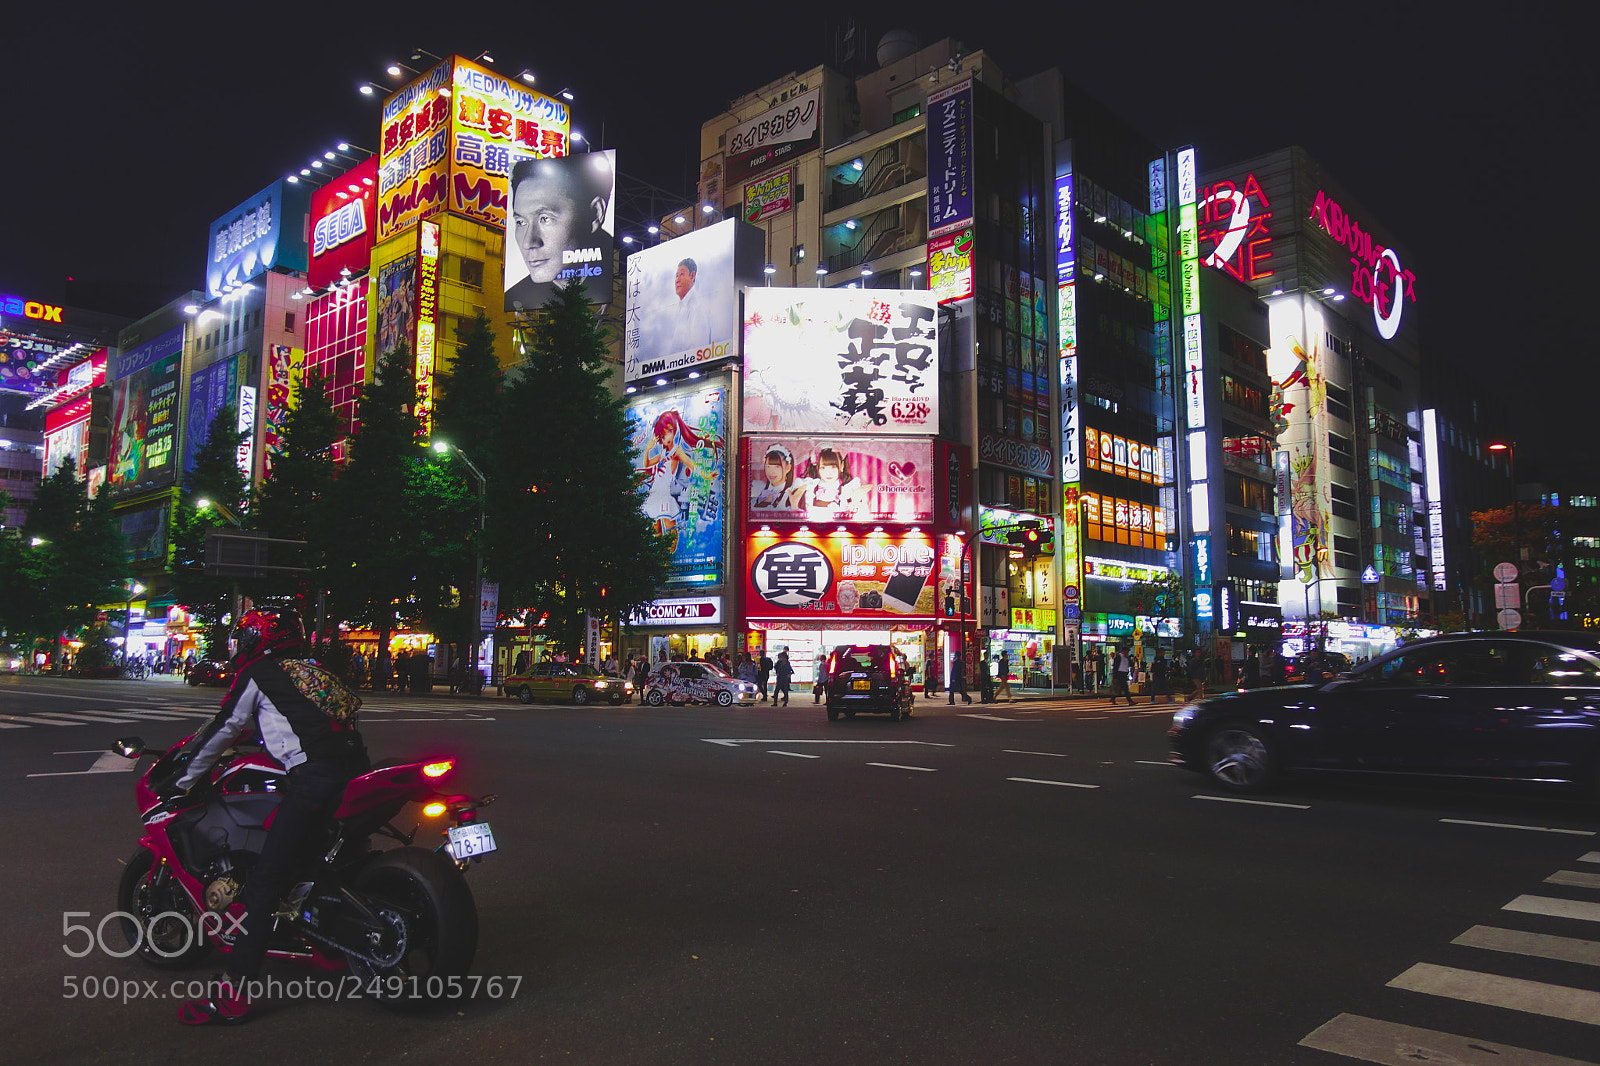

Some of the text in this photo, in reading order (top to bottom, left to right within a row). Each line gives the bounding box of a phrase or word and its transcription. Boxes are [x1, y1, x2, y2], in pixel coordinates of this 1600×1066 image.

[454, 65, 567, 123] MEDIAリサイクル
[383, 95, 450, 156] 激安販売
[459, 94, 564, 158] 激安販売
[730, 100, 815, 154] メイドカジノ
[380, 129, 447, 196] 高額買取
[774, 144, 792, 157] STARS
[380, 172, 448, 237] Mulan
[465, 206, 500, 226] ムーラン
[1197, 173, 1270, 226] IBA
[312, 198, 367, 258] SEGA
[562, 247, 603, 264] DMM
[931, 251, 970, 273] まんが
[1183, 229, 1193, 310] Yellow Submarine
[626, 255, 643, 380] 次は太陽か。
[696, 341, 730, 362] solar
[242, 390, 253, 429] AKKY
[891, 401, 927, 419] 6.28
[981, 435, 1052, 473] メイドカジノ
[877, 483, 907, 493] @home
[760, 551, 823, 599] 質
[882, 565, 931, 577] スマホ
[1041, 570, 1049, 603] ルノアール
[1066, 588, 1076, 596] 40
[649, 605, 700, 618] COMIC ZIN
[1108, 619, 1134, 630] リバティー
